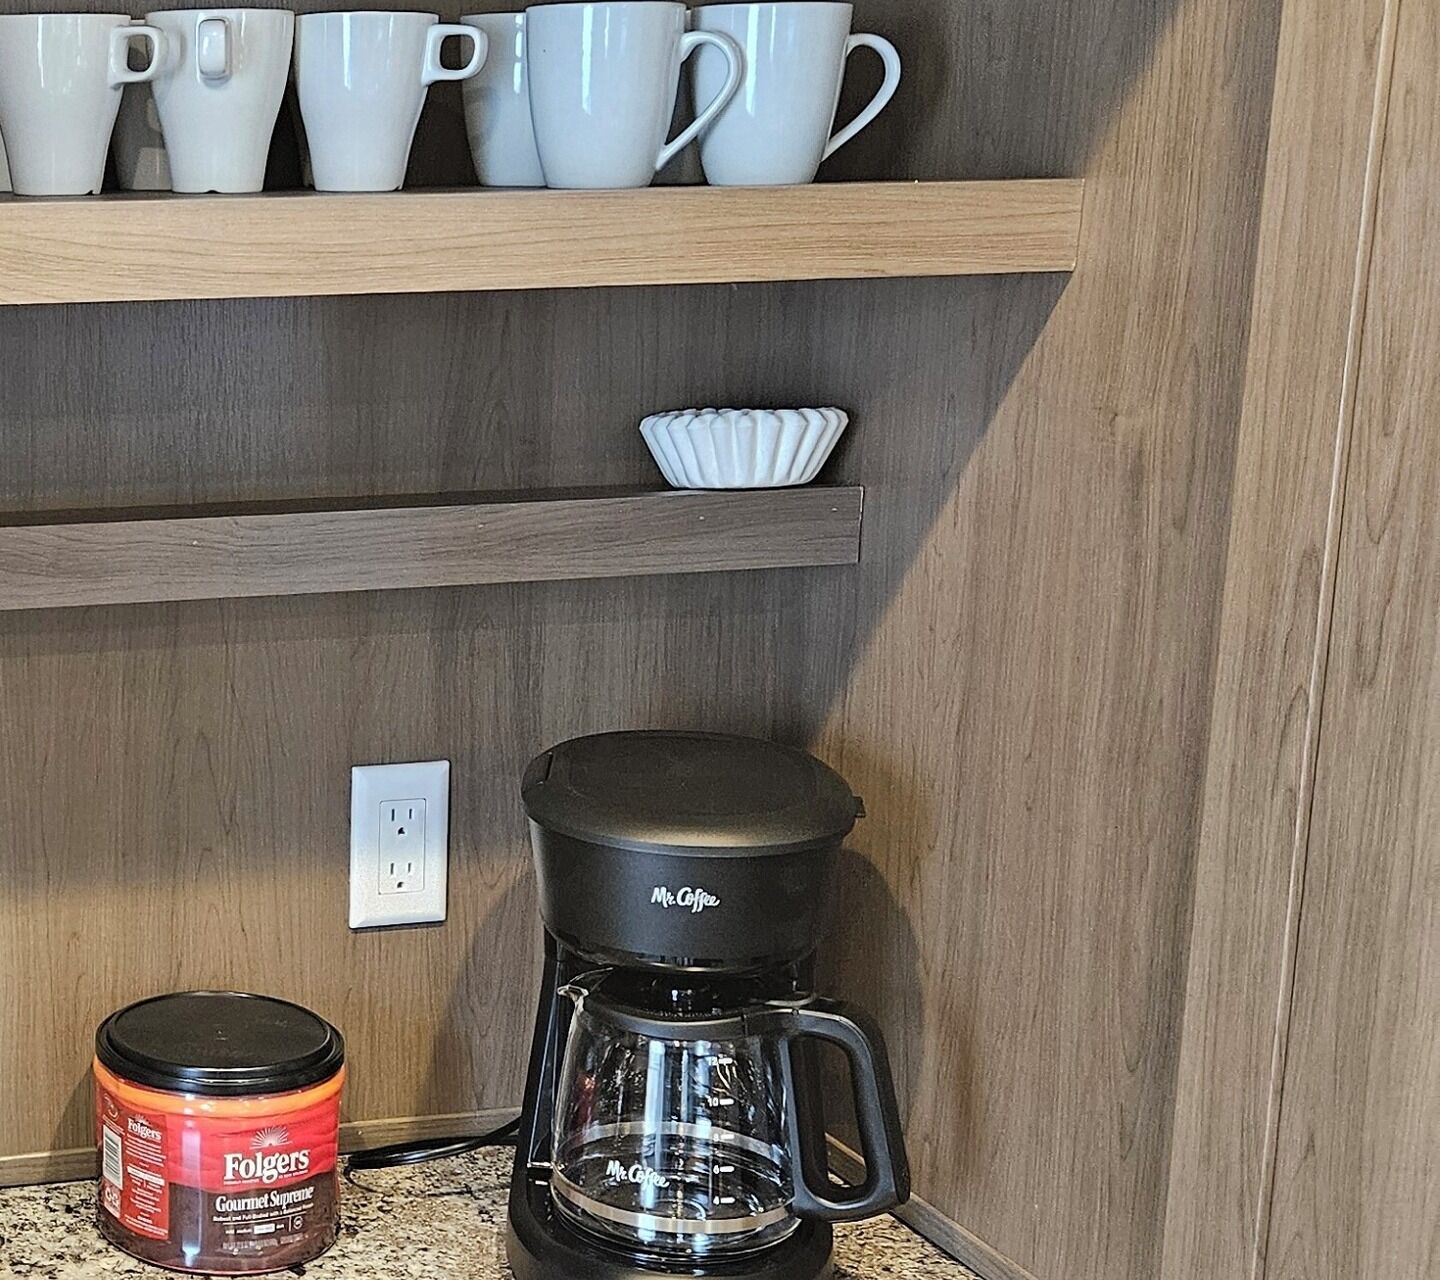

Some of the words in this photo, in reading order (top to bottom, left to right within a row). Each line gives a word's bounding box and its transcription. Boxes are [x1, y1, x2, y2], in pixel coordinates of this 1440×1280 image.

[650, 886, 676, 908] Mr.
[676, 886, 721, 914] Coffee
[127, 1117, 162, 1141] Folgers
[223, 1149, 311, 1184] Folgers
[605, 1159, 627, 1182] Mr.
[628, 1163, 670, 1190] Coffee
[215, 1193, 268, 1212] Gourmet
[269, 1186, 315, 1209] Supreme
